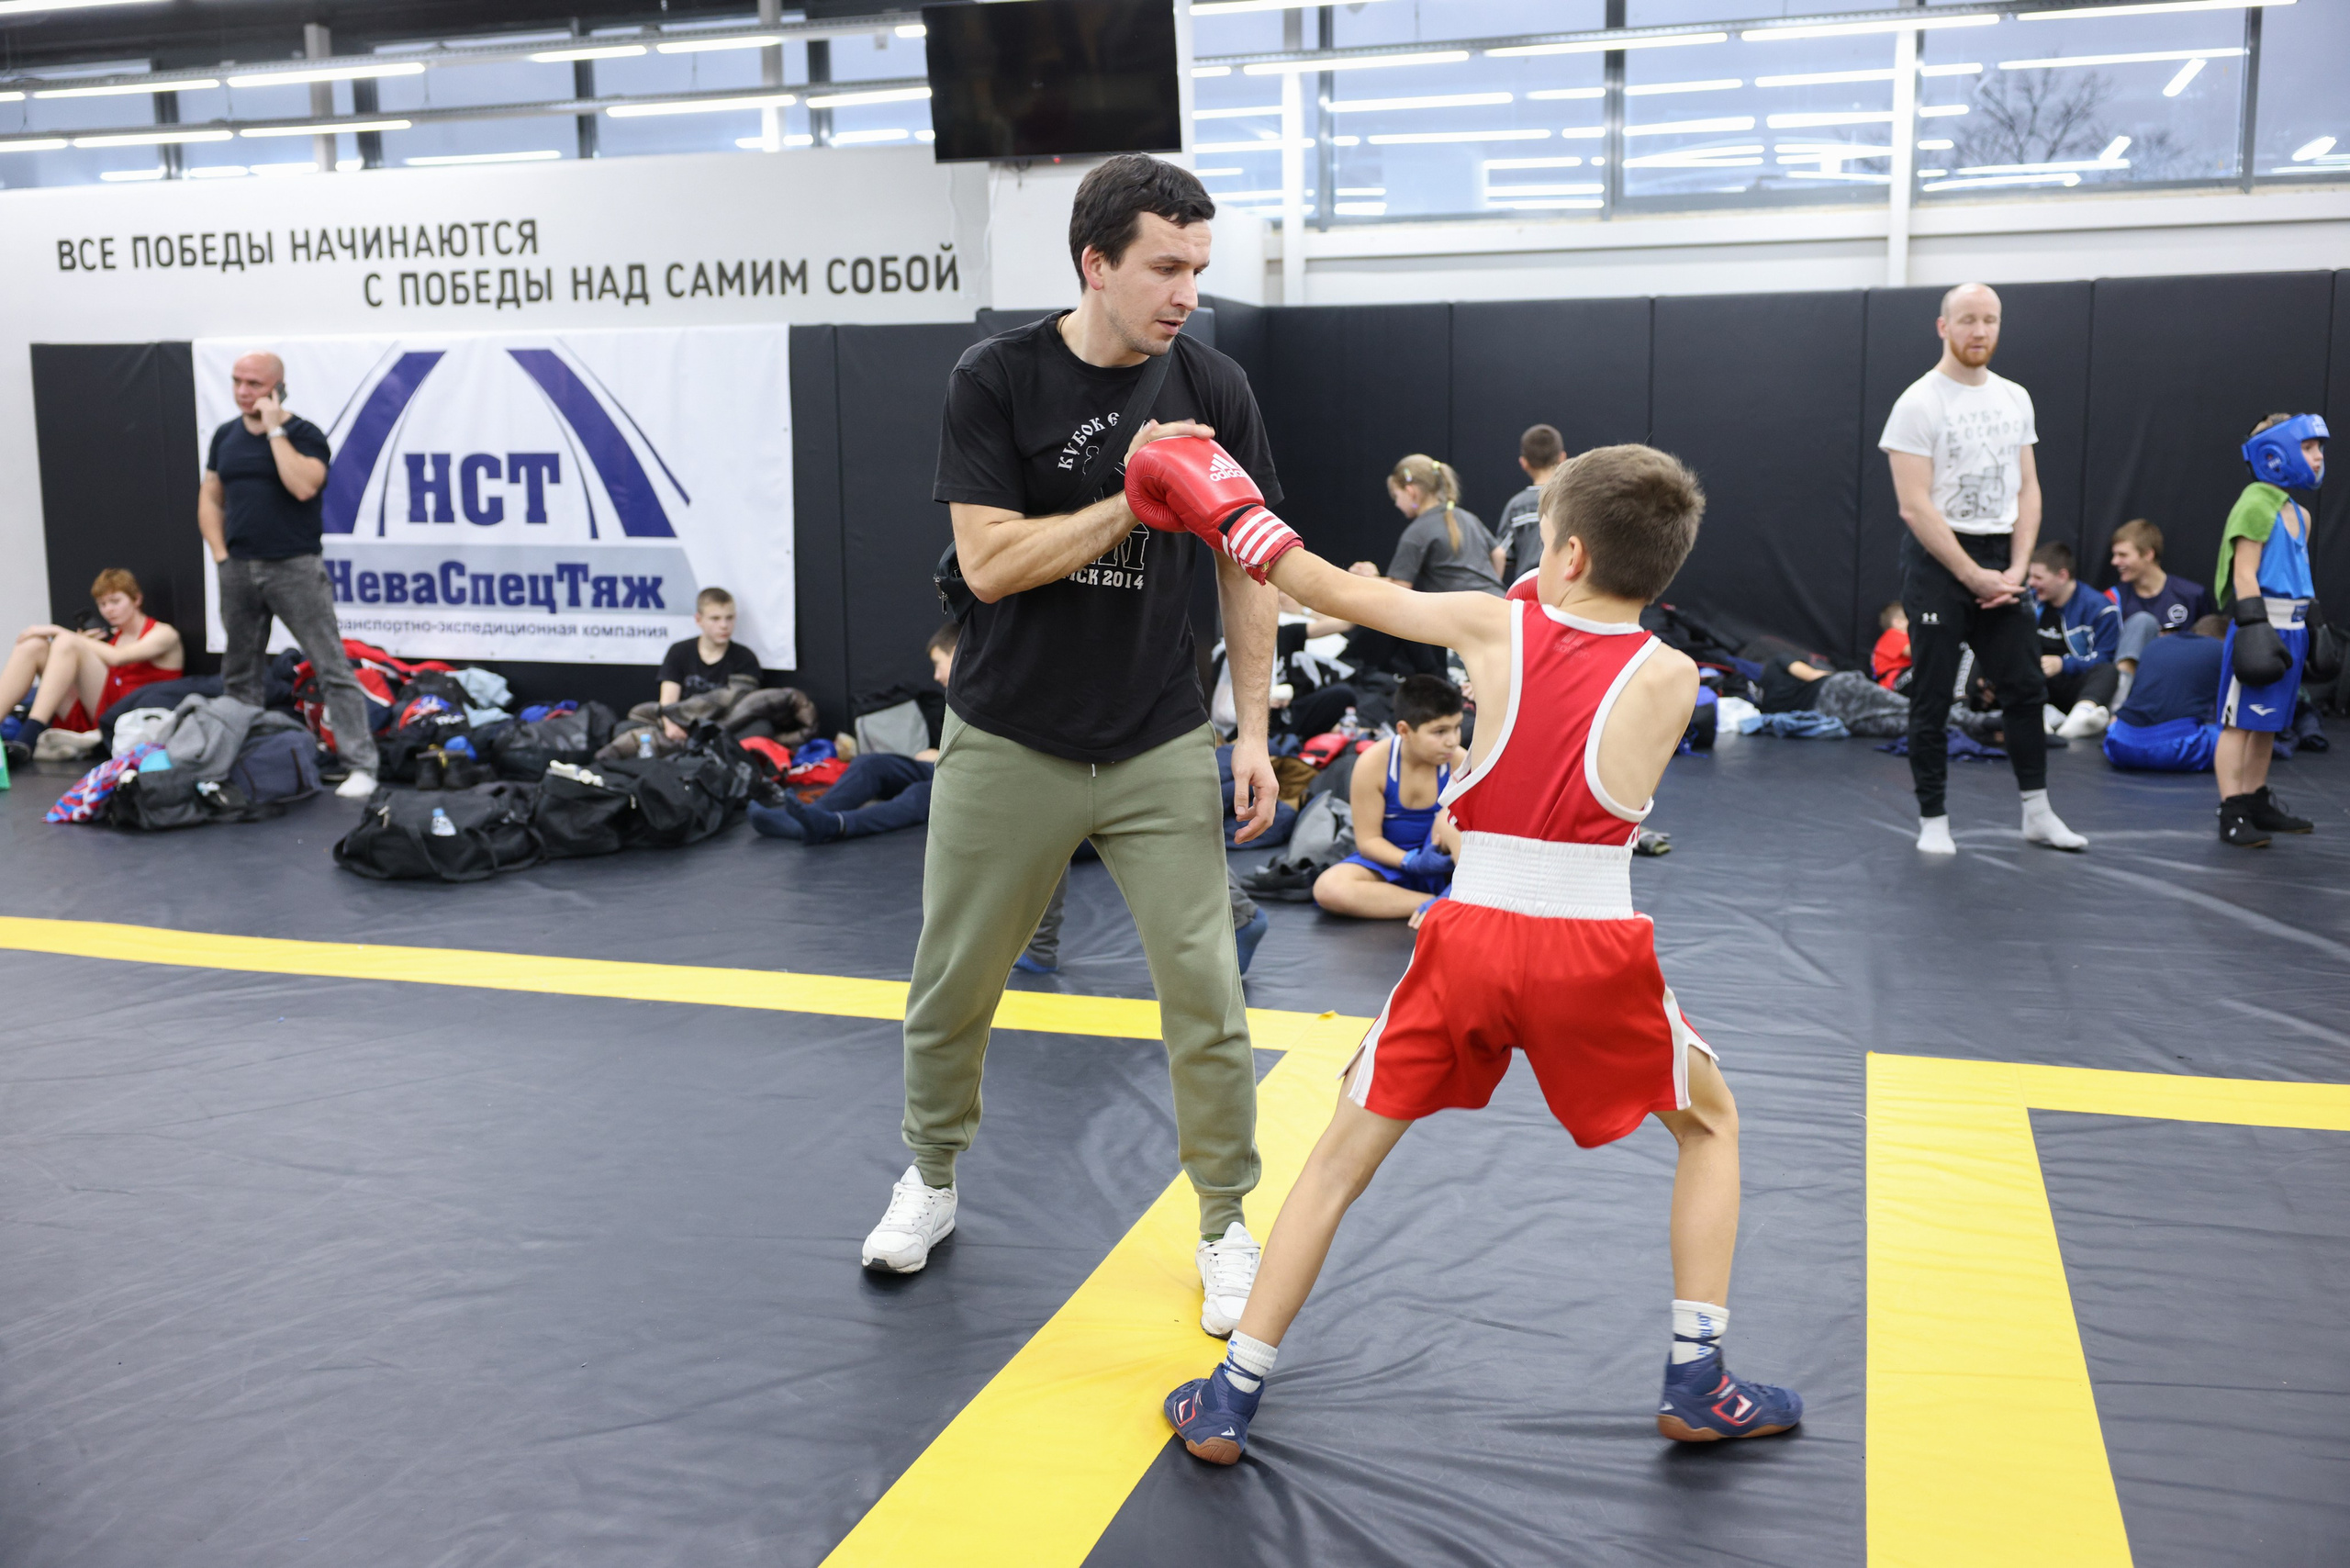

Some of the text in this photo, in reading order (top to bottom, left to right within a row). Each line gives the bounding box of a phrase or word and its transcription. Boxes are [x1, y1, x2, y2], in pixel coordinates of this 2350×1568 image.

[57, 218, 538, 273] ВСЕ ПОБЕДЫ НАЧИНАЮТСЯ
[364, 242, 959, 310] С ПОБЕДЫ НАД САМИМ СОБОЙ
[404, 452, 562, 527] НСТ
[324, 559, 666, 614] НеваСпецТяж
[1102, 570, 1145, 590] 2014
[336, 616, 668, 638] ранспортно-экспедиционная компания
